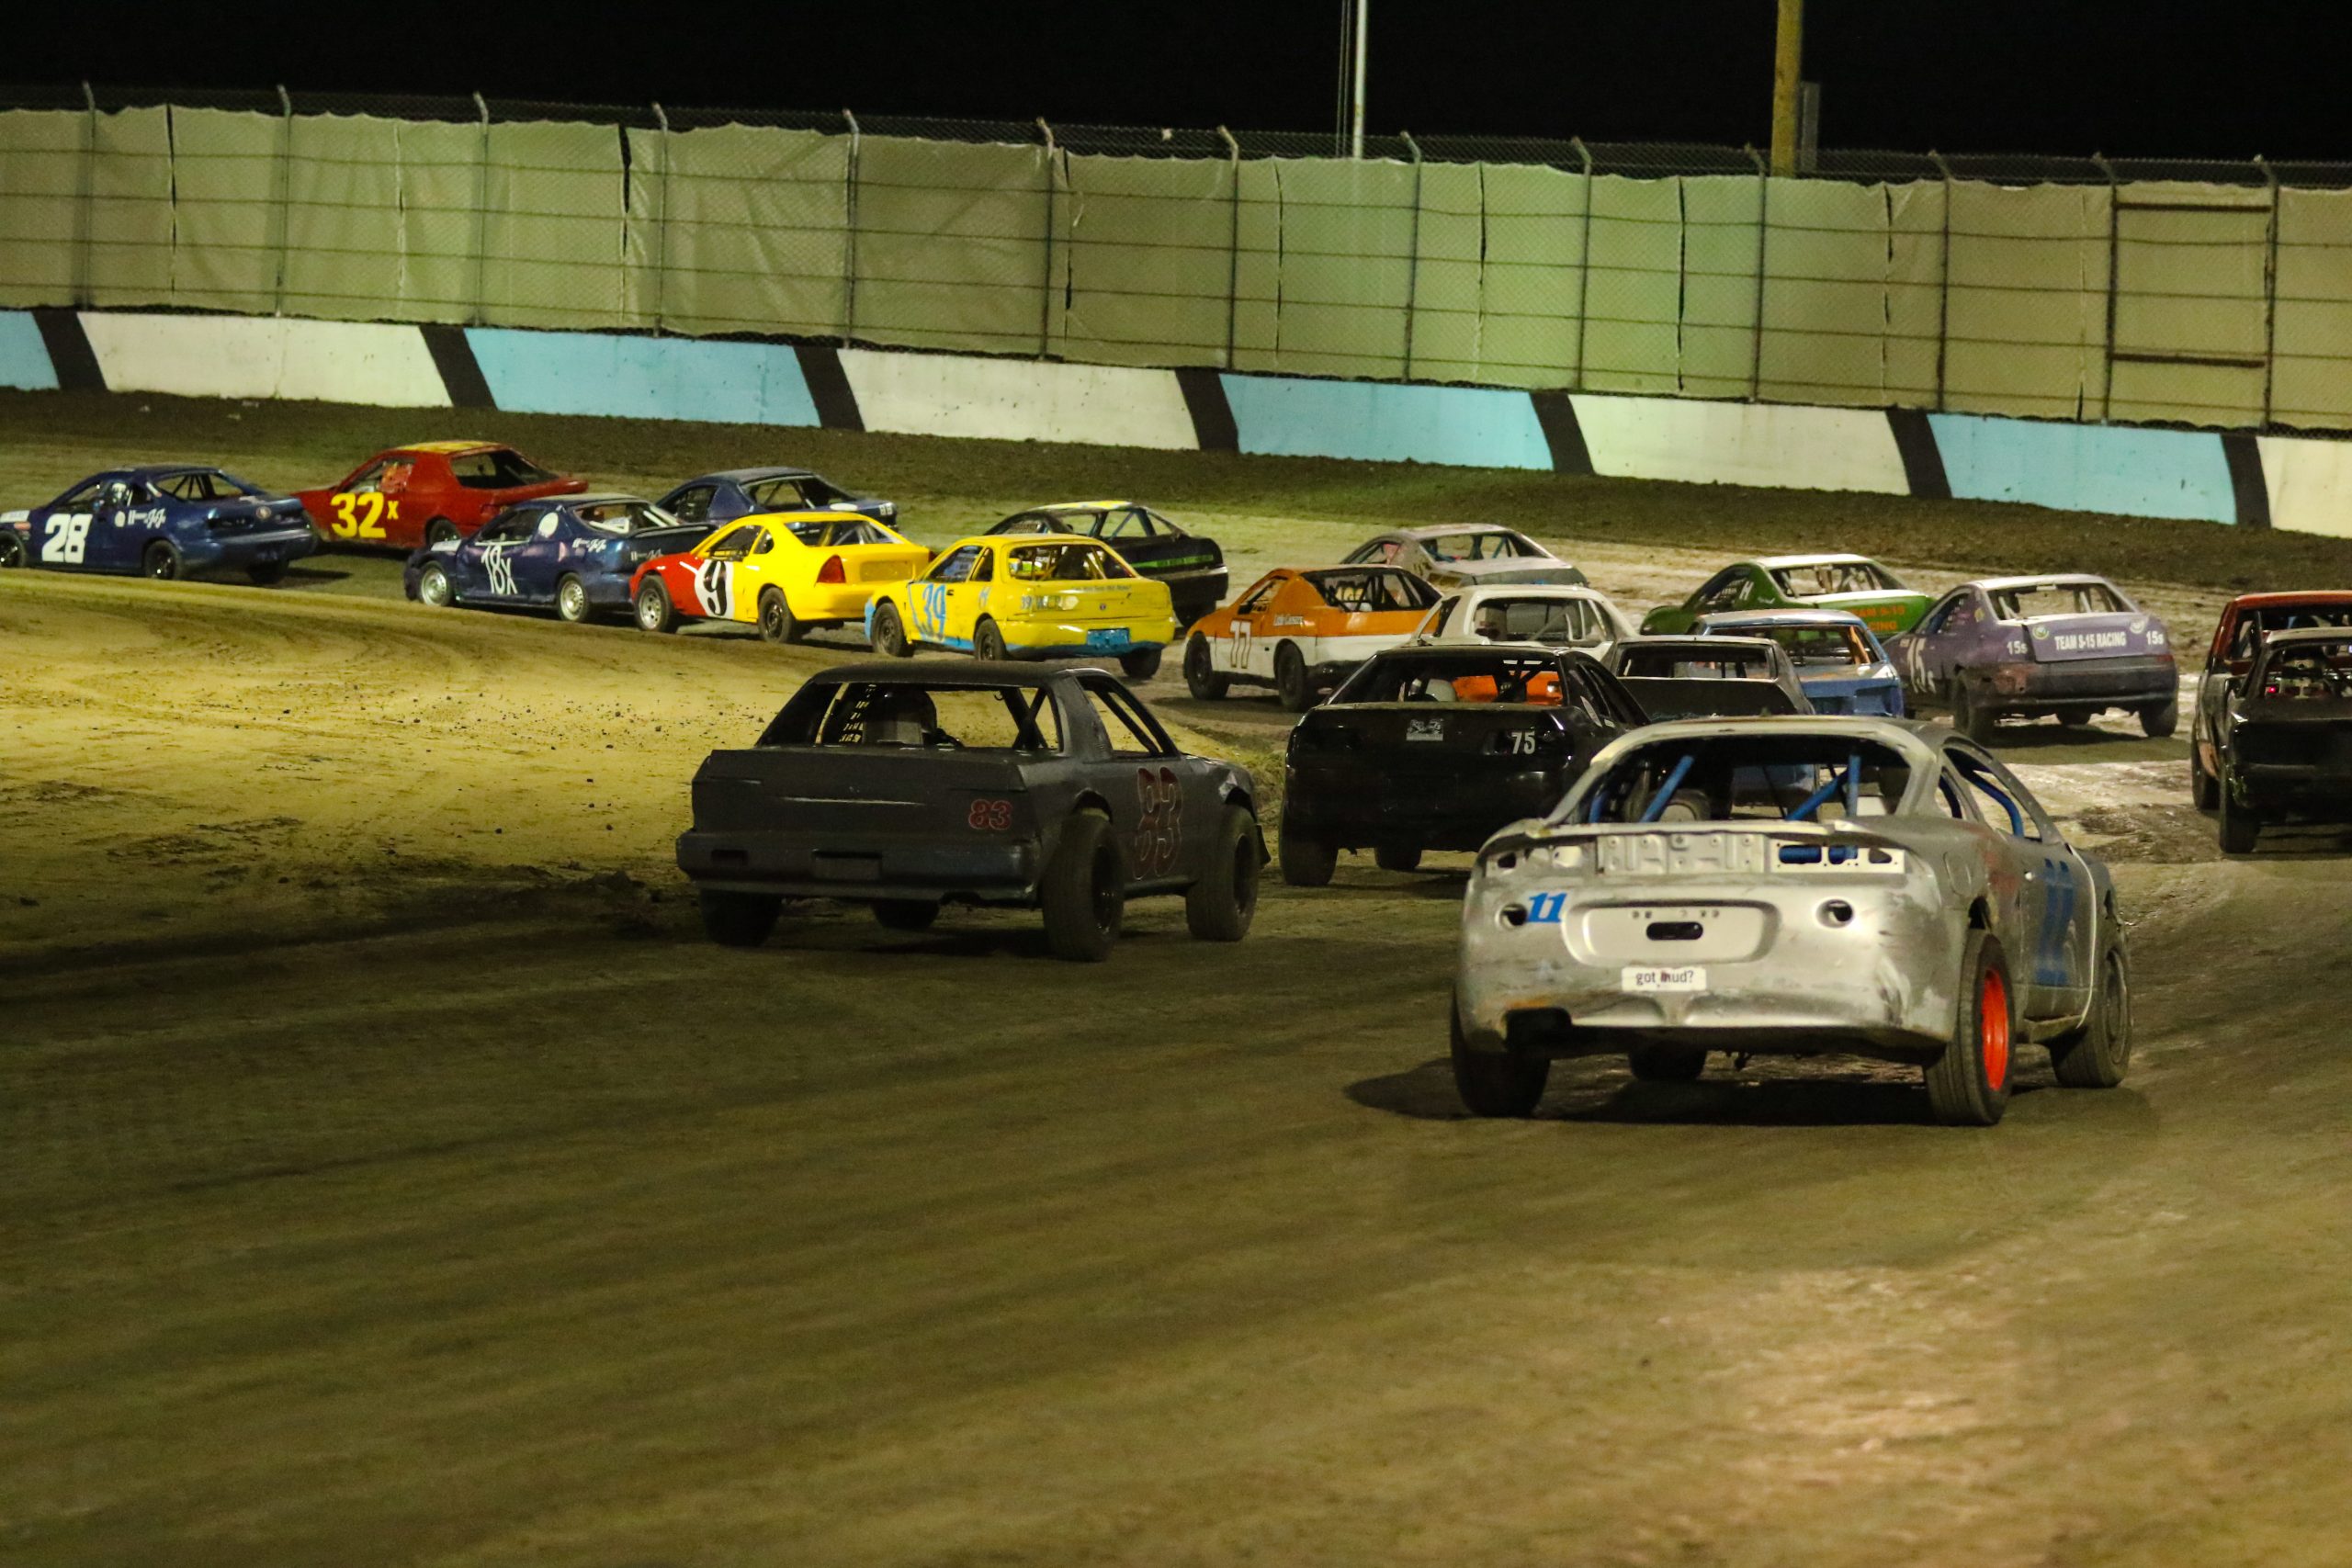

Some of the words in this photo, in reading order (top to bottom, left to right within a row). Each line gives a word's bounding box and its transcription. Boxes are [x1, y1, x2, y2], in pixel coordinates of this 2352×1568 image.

[42, 513, 93, 563] 28
[703, 560, 728, 616] 9
[1229, 617, 1253, 670] 77
[2054, 634, 2077, 650] TEAM
[2078, 632, 2096, 649] S-15
[2097, 630, 2127, 648] RACING
[1511, 730, 1535, 754] 75
[968, 799, 1012, 830] 83
[1132, 766, 1182, 881] 83
[1528, 892, 1567, 923] 11
[1635, 972, 1656, 986] got
[1660, 969, 1695, 983] mud?
